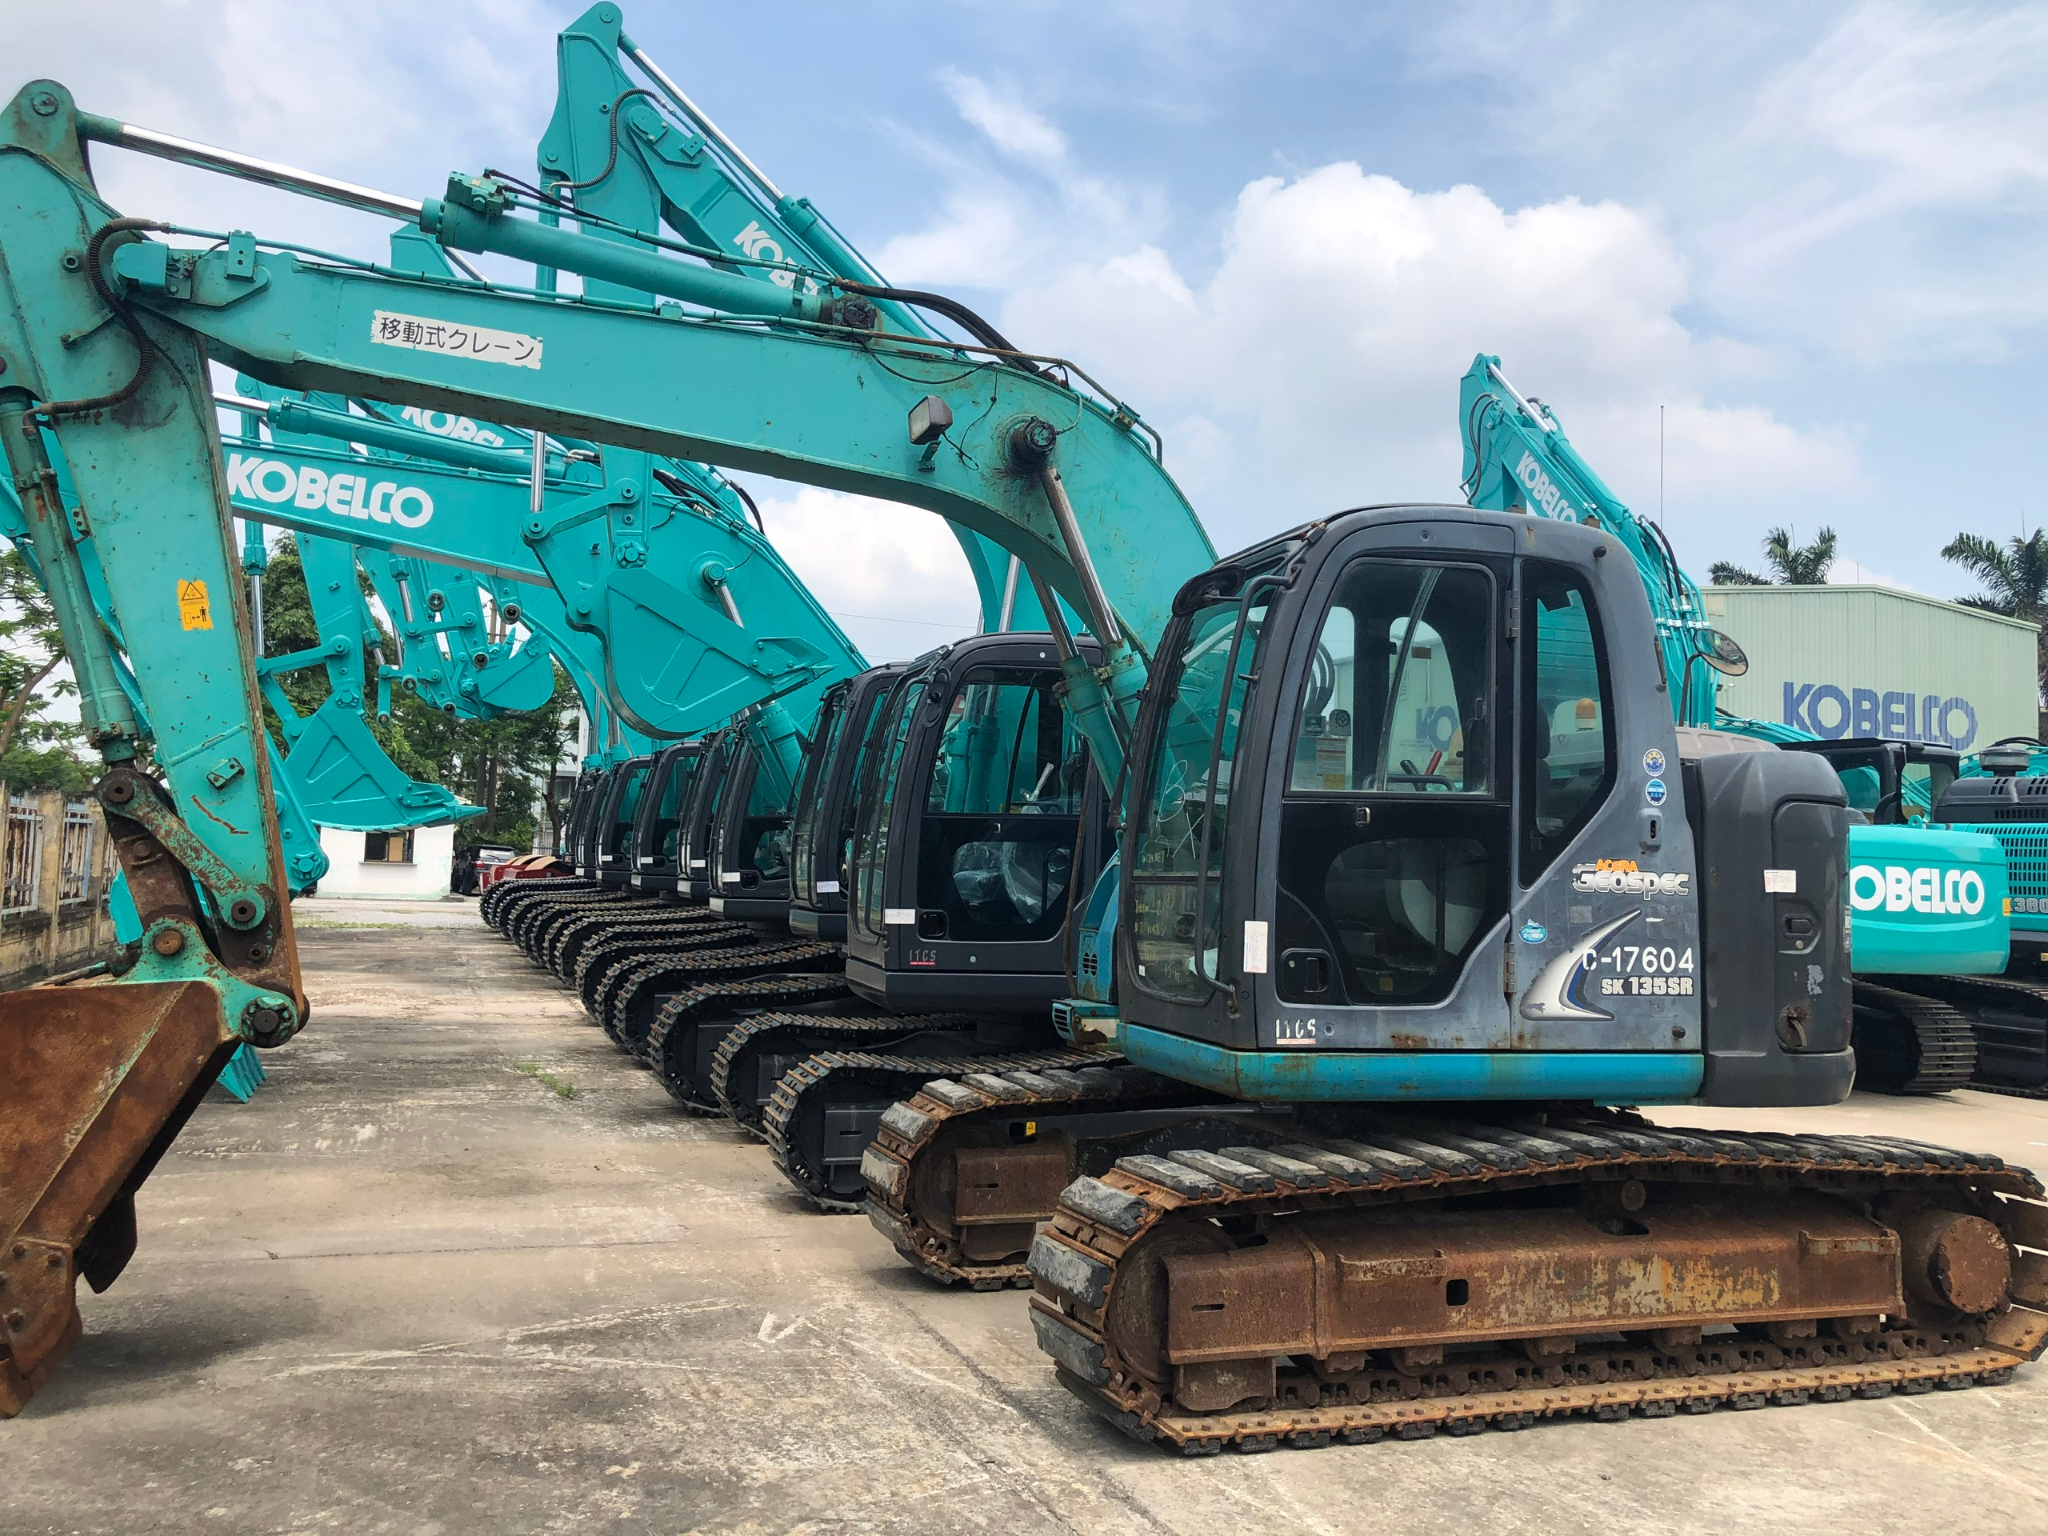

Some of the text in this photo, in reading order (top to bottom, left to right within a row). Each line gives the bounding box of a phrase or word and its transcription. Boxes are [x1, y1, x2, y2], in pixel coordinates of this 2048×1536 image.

[379, 317, 534, 361] 移動式クレーン
[227, 453, 434, 528] KOBELCO
[1516, 449, 1577, 524] KOBELCO
[1783, 682, 1978, 751] KOBELCO
[1595, 858, 1639, 873] ACERA
[1850, 865, 1985, 915] OBELCO
[2009, 897, 2048, 914] 380
[909, 949, 937, 962] ITCS
[1582, 946, 1695, 973] C-17604
[1601, 976, 1693, 995] SK 135SR
